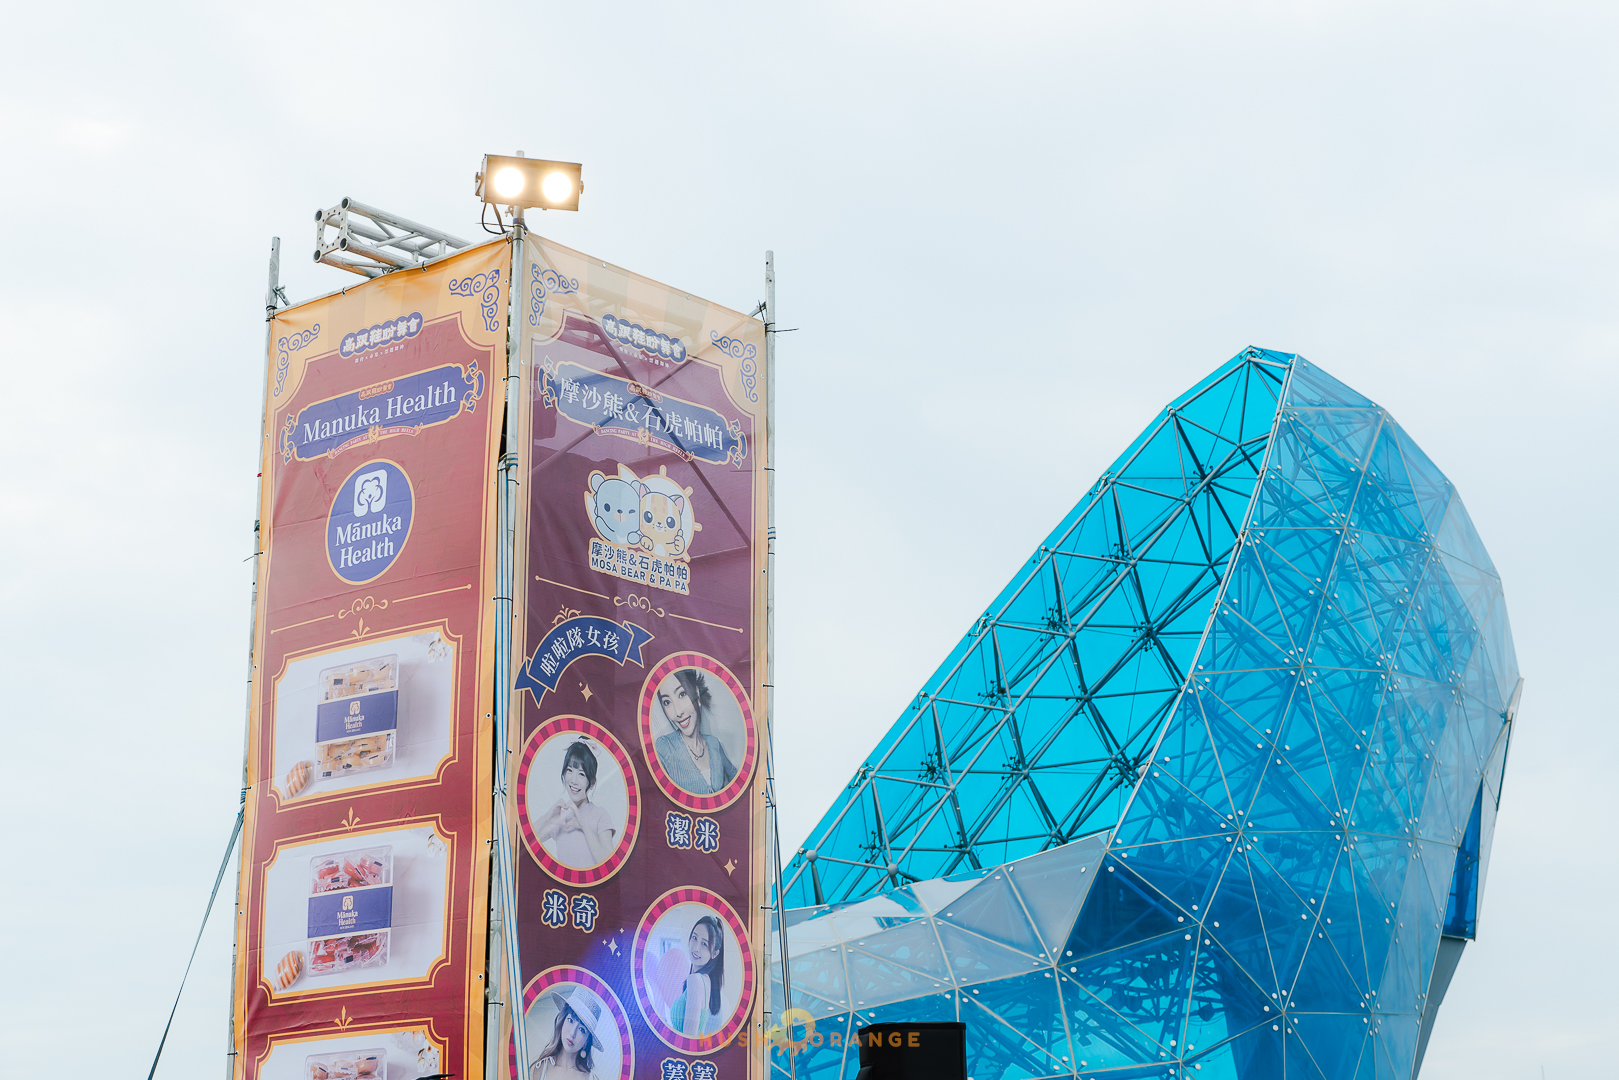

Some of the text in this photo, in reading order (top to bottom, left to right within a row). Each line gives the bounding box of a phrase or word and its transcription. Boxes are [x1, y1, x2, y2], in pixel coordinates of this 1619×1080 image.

[302, 405, 380, 444] Manuka
[386, 381, 456, 420] Health
[559, 377, 723, 451] 摩沙熊&石虎帕帕
[335, 513, 402, 546] Mānuka
[339, 536, 394, 569] Health
[591, 541, 688, 580] 摩沙熊&石虎帕帕
[591, 557, 687, 592] MOSA BEAR & PA PA
[540, 626, 620, 677] 啦啦隊女孩
[668, 813, 717, 850] 潔米
[544, 891, 596, 928] 米奇
